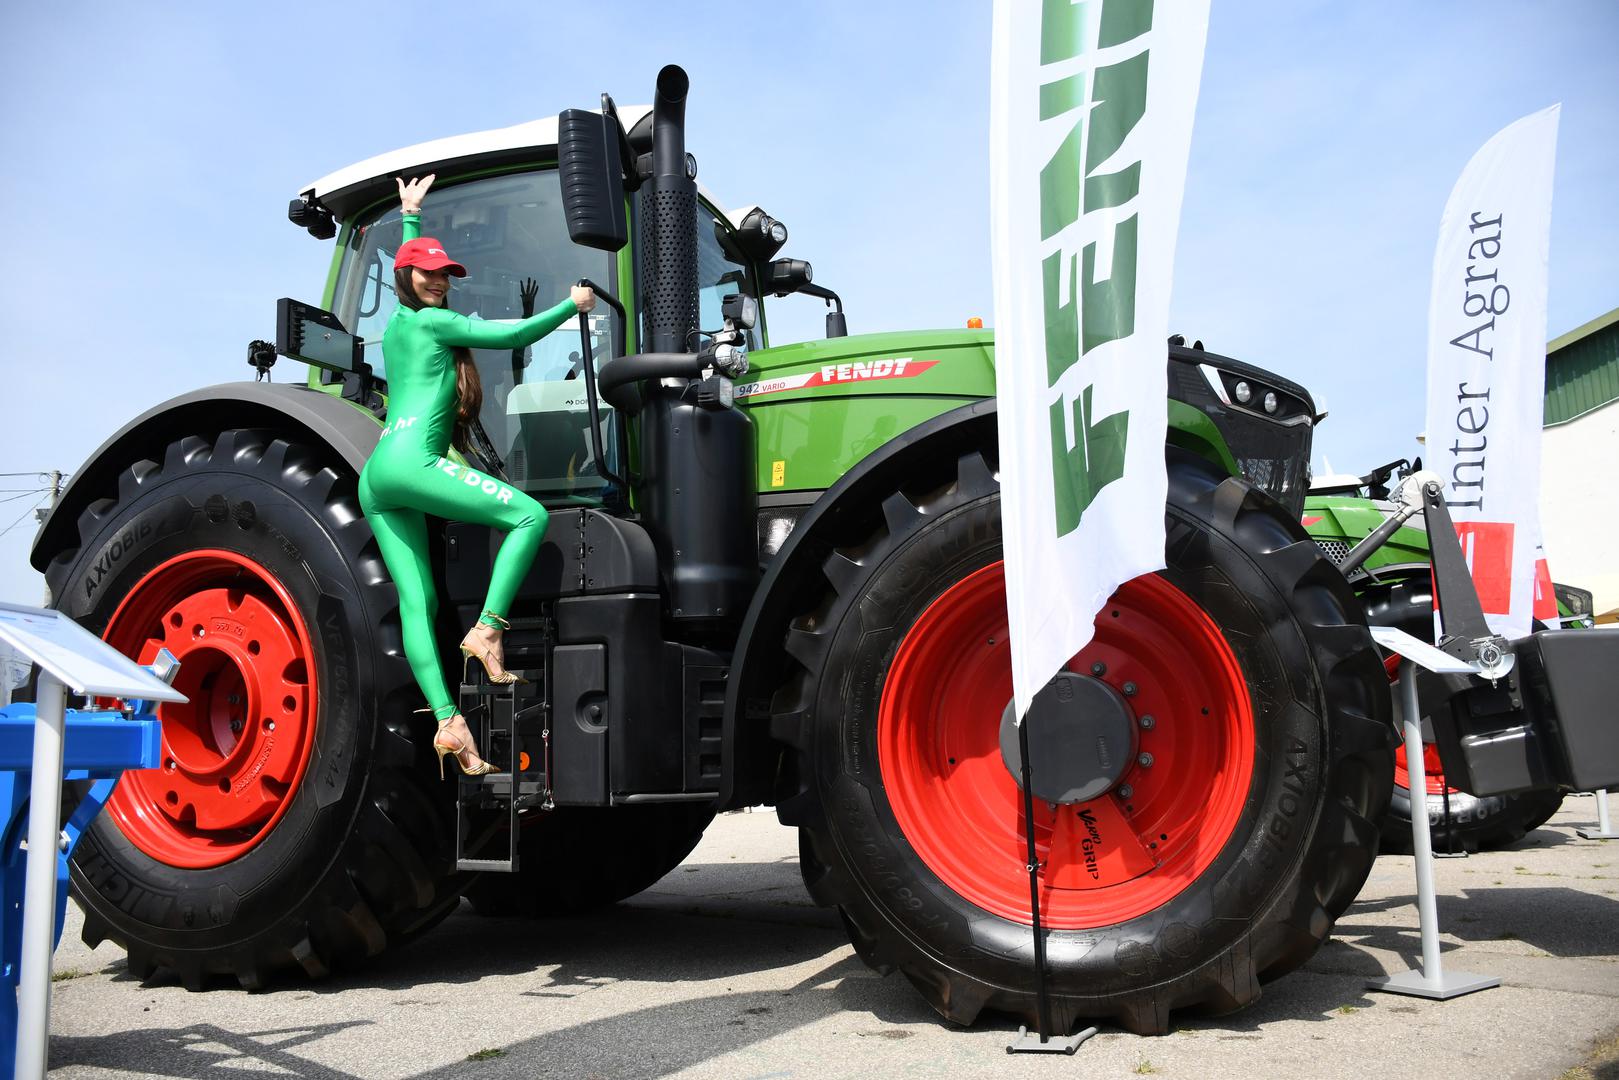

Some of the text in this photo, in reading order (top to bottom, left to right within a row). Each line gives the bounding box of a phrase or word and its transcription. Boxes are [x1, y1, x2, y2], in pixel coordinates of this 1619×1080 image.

[821, 358, 913, 382] FENDT
[1446, 211, 1510, 512] Inter Agrar
[739, 381, 786, 396] 942 VARIO
[1081, 837, 1099, 881] GRIP
